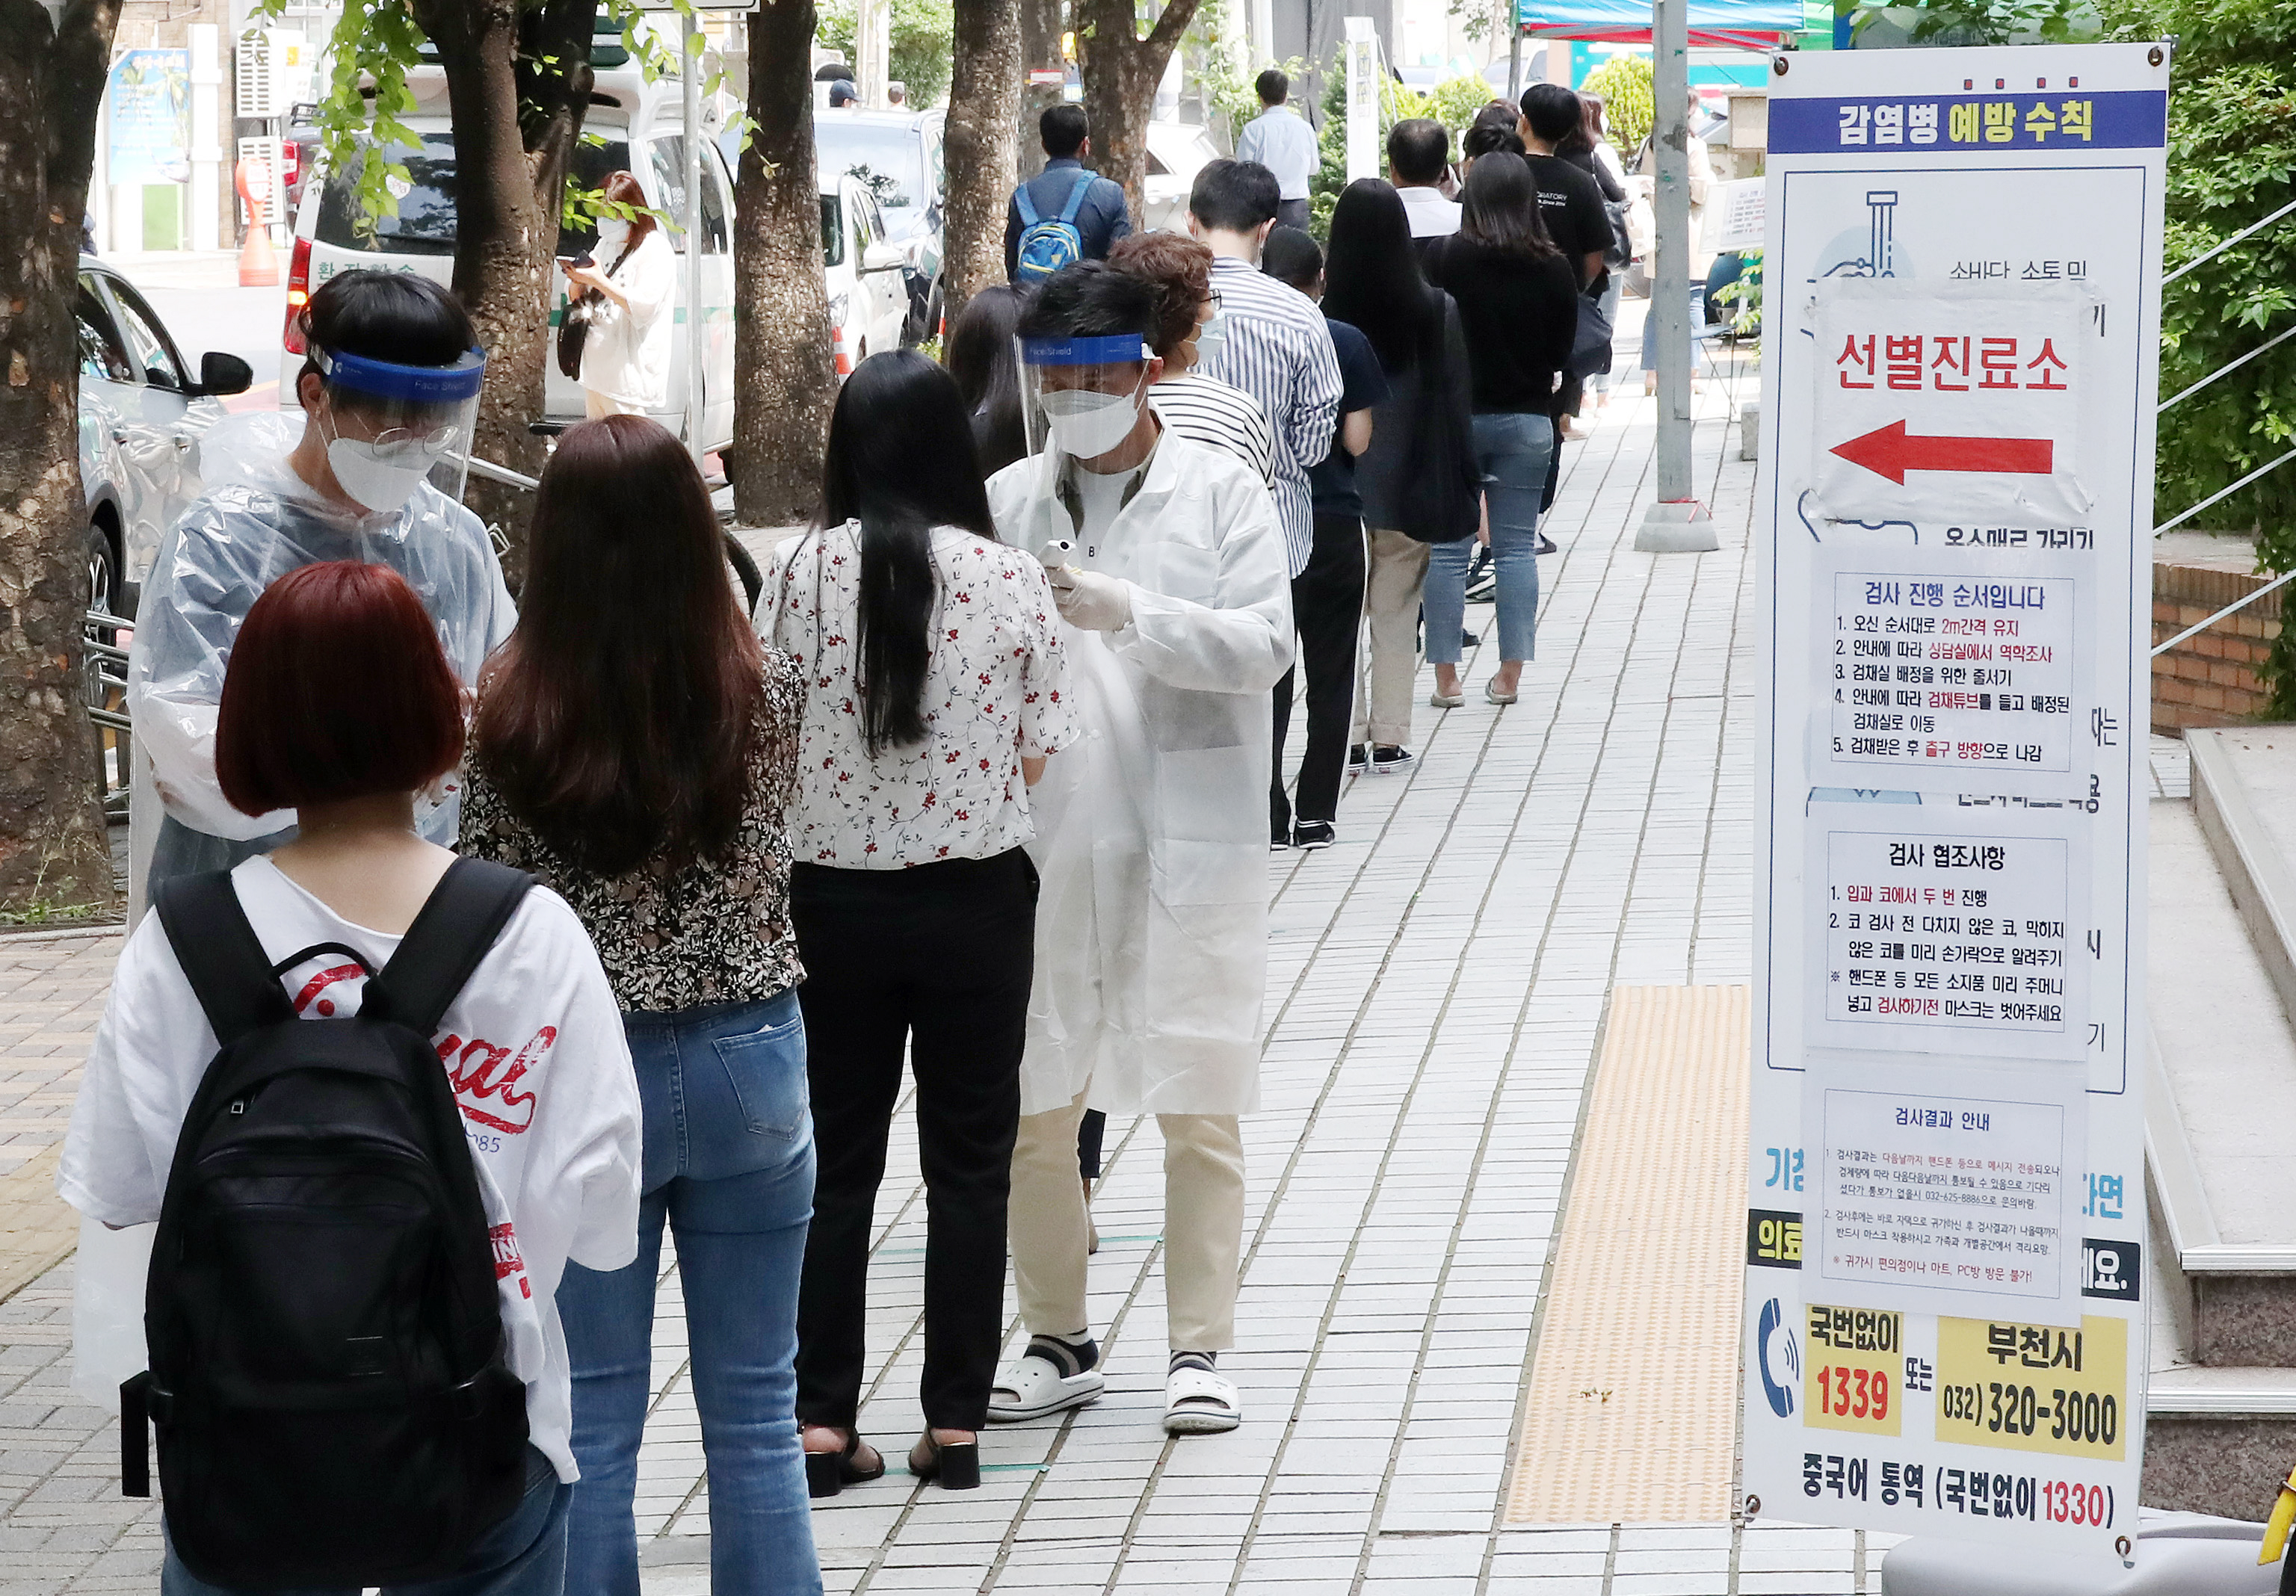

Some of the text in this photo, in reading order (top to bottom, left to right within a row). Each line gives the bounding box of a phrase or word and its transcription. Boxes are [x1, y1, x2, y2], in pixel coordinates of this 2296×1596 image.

[1839, 100, 2093, 145] 감염병 예방 수칙
[1837, 334, 2067, 392] 선별진료소
[1866, 581, 2045, 609] 검사 진행 순서입니다
[1837, 616, 2018, 637] 1. 오신 순서대로 2m간격 유지
[1836, 640, 2052, 663] 2. 안내에 따라 상담실에서 역학조사
[1835, 665, 2011, 687] 3. 검채실 배정을 위한 줄서기
[1835, 689, 2070, 714] 4. 안내에 따라 검채튜브를 들고 배정된
[1854, 714, 1934, 733] 검채실로 이동
[1833, 737, 2041, 762] 5. 검채받은 후 출구 방향으로 나감
[1889, 843, 2005, 870] 검사 협조사항
[1831, 885, 1987, 907] 1. 입과 코에서 두 번 진행
[1830, 914, 2064, 938] 2. 코 검사 전 다치지 않은 코, 막히지
[1849, 942, 2062, 967] 않은 코를 미리 손가락으로 알려주기
[1849, 969, 2062, 995] 핸드폰 등 모든 소지품 미리 주머니
[1848, 995, 2061, 1022] 넣고 검사하기전 마스크는 벗어주세요
[1895, 1107, 1990, 1130] 검사결과 안내
[1809, 1306, 1898, 1352] 국번없이
[1987, 1324, 2081, 1372] 부천시
[1905, 1357, 1932, 1391] 또는
[1818, 1366, 1888, 1420] 1339
[1944, 1383, 2116, 1445] 032) 320-3000
[1803, 1453, 1868, 1501] 중국어
[1882, 1462, 1923, 1508] 통역
